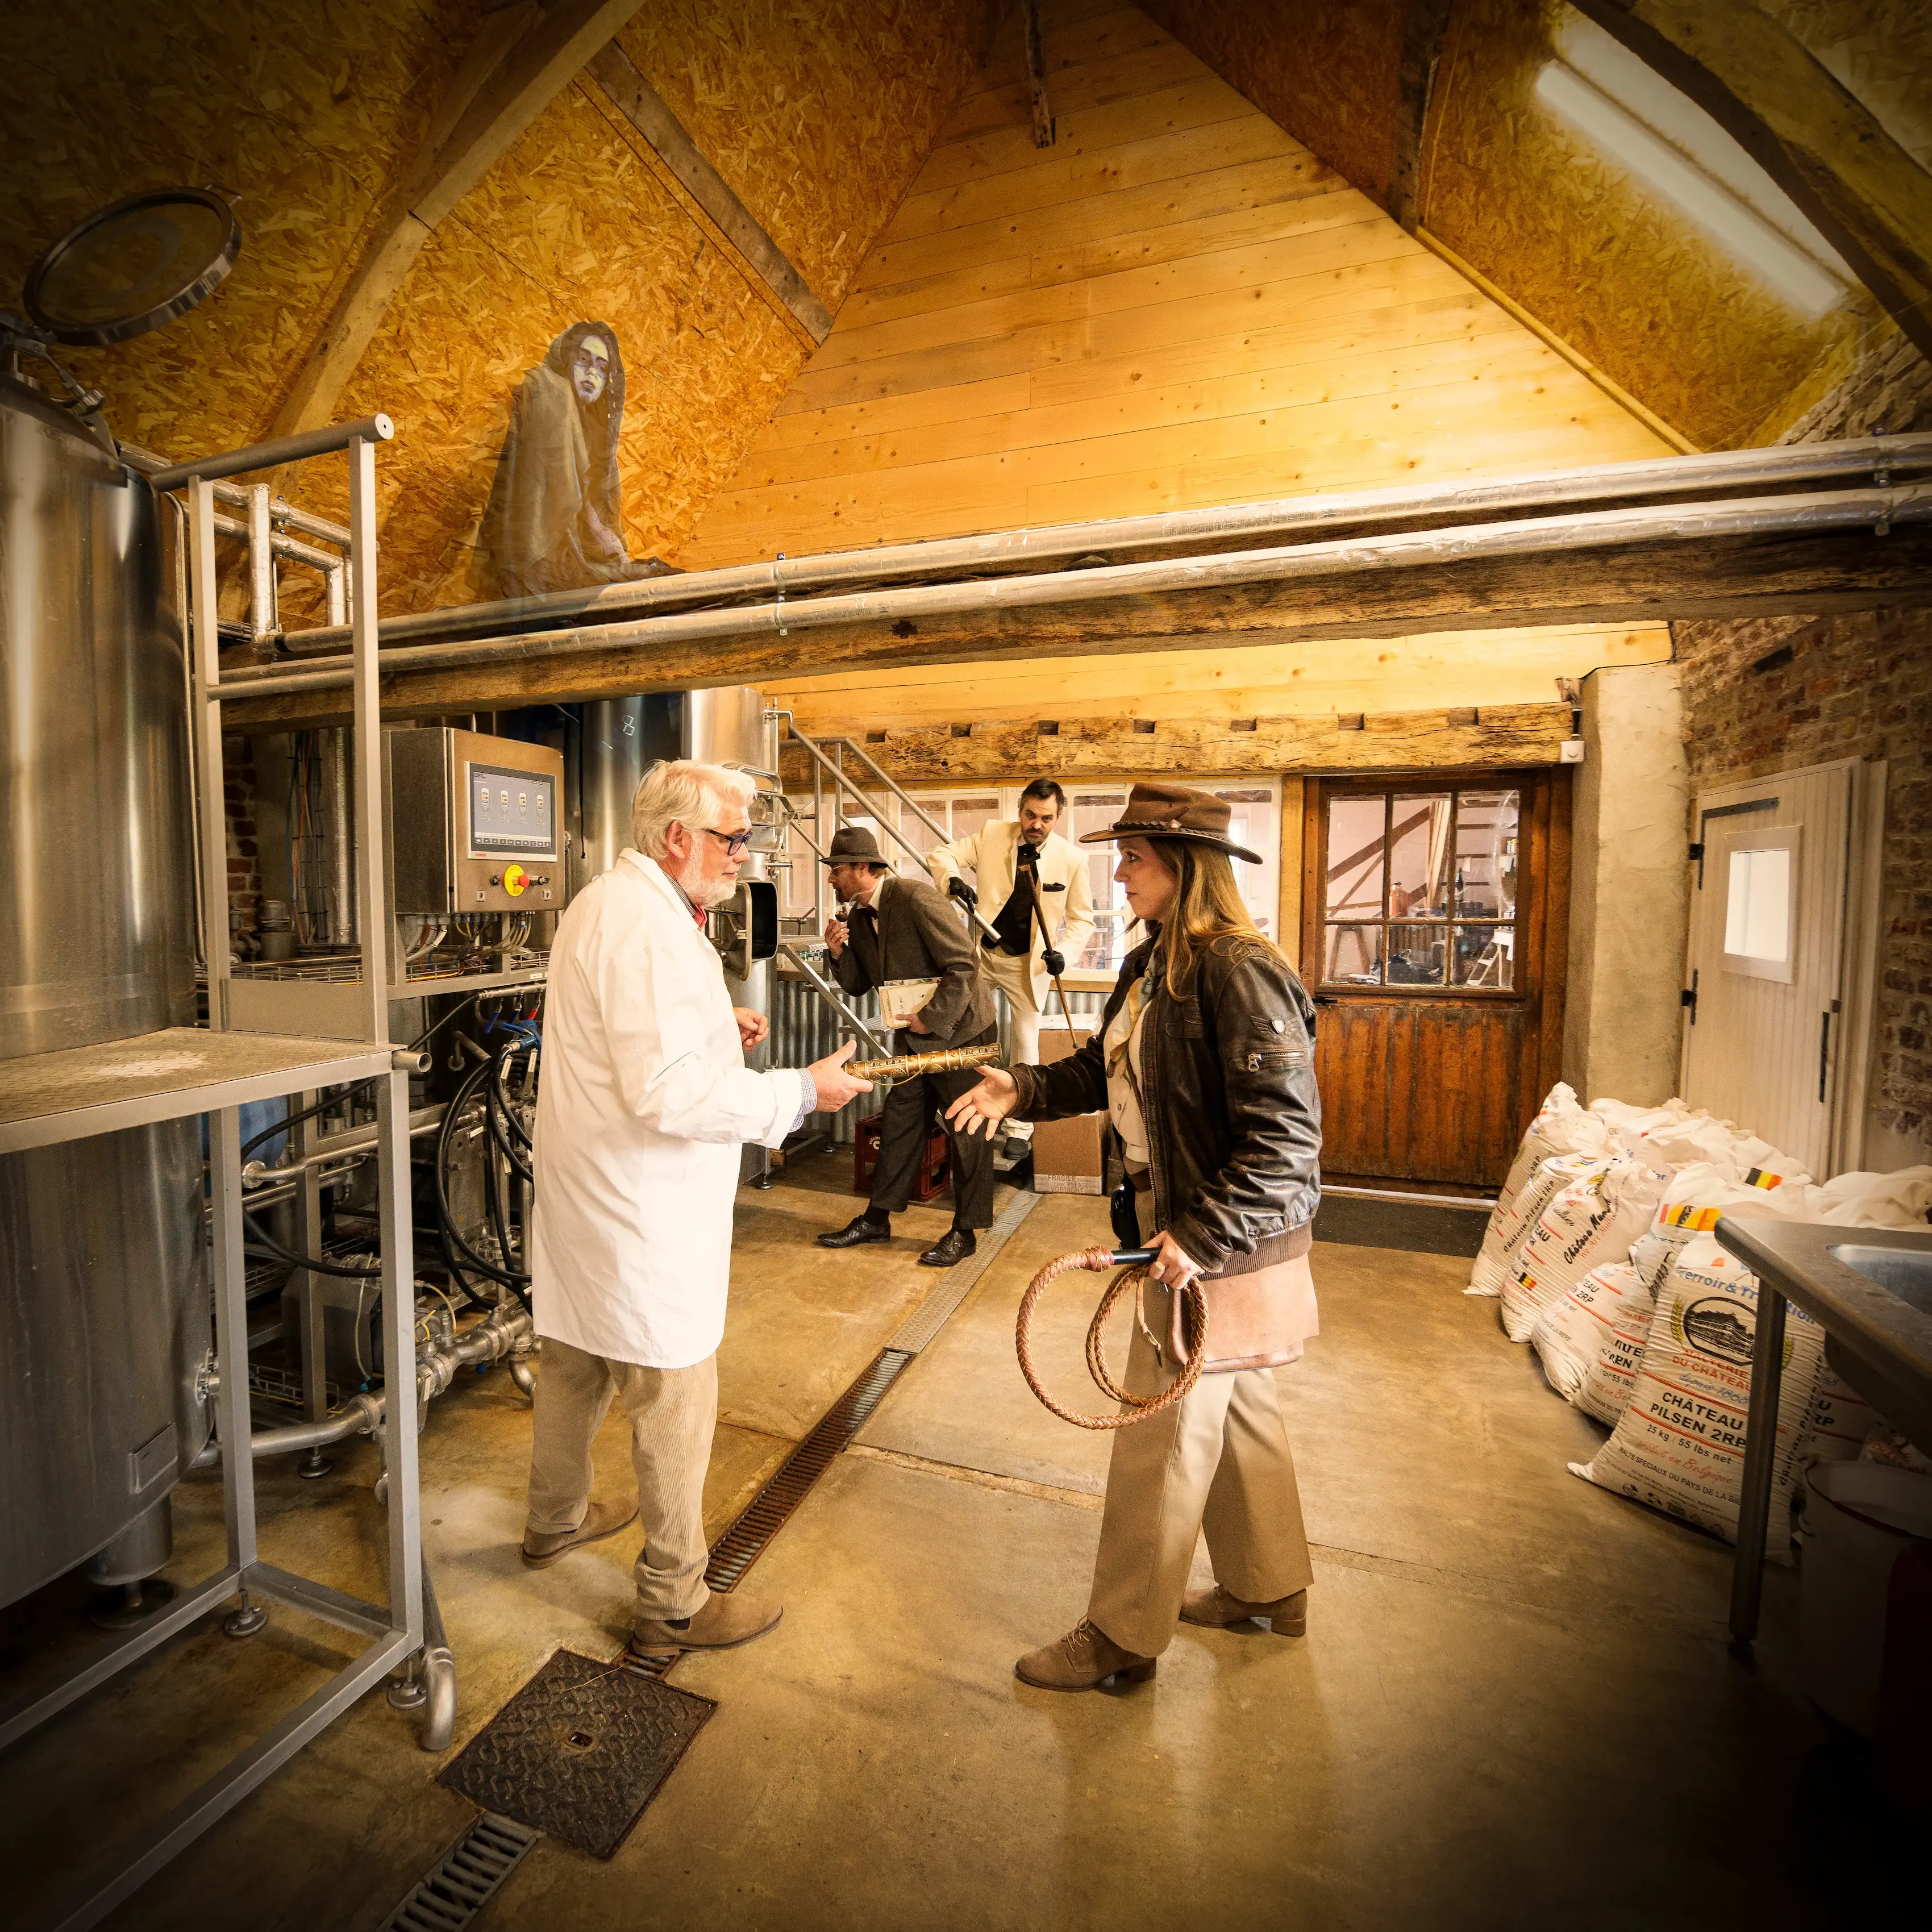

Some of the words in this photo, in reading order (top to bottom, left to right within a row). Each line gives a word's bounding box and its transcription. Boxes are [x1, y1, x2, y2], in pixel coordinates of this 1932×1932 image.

[1576, 1290, 1594, 1303] 2RP
[1672, 1356, 1688, 1367] DU
[1650, 1402, 1706, 1435] PILSEN
[1710, 1427, 1747, 1448] 2RP
[1662, 1392, 1744, 1430] CHÂTEAU
[1647, 1423, 1657, 1434] 25
[1658, 1429, 1669, 1442] kg
[1677, 1438, 1692, 1450] 55
[1693, 1443, 1710, 1458] lbs
[1712, 1452, 1732, 1465] net
[1668, 1472, 1680, 1482] DU
[1680, 1477, 1701, 1493] PAYS
[1702, 1486, 1715, 1497] DE
[1715, 1491, 1727, 1501] LA
